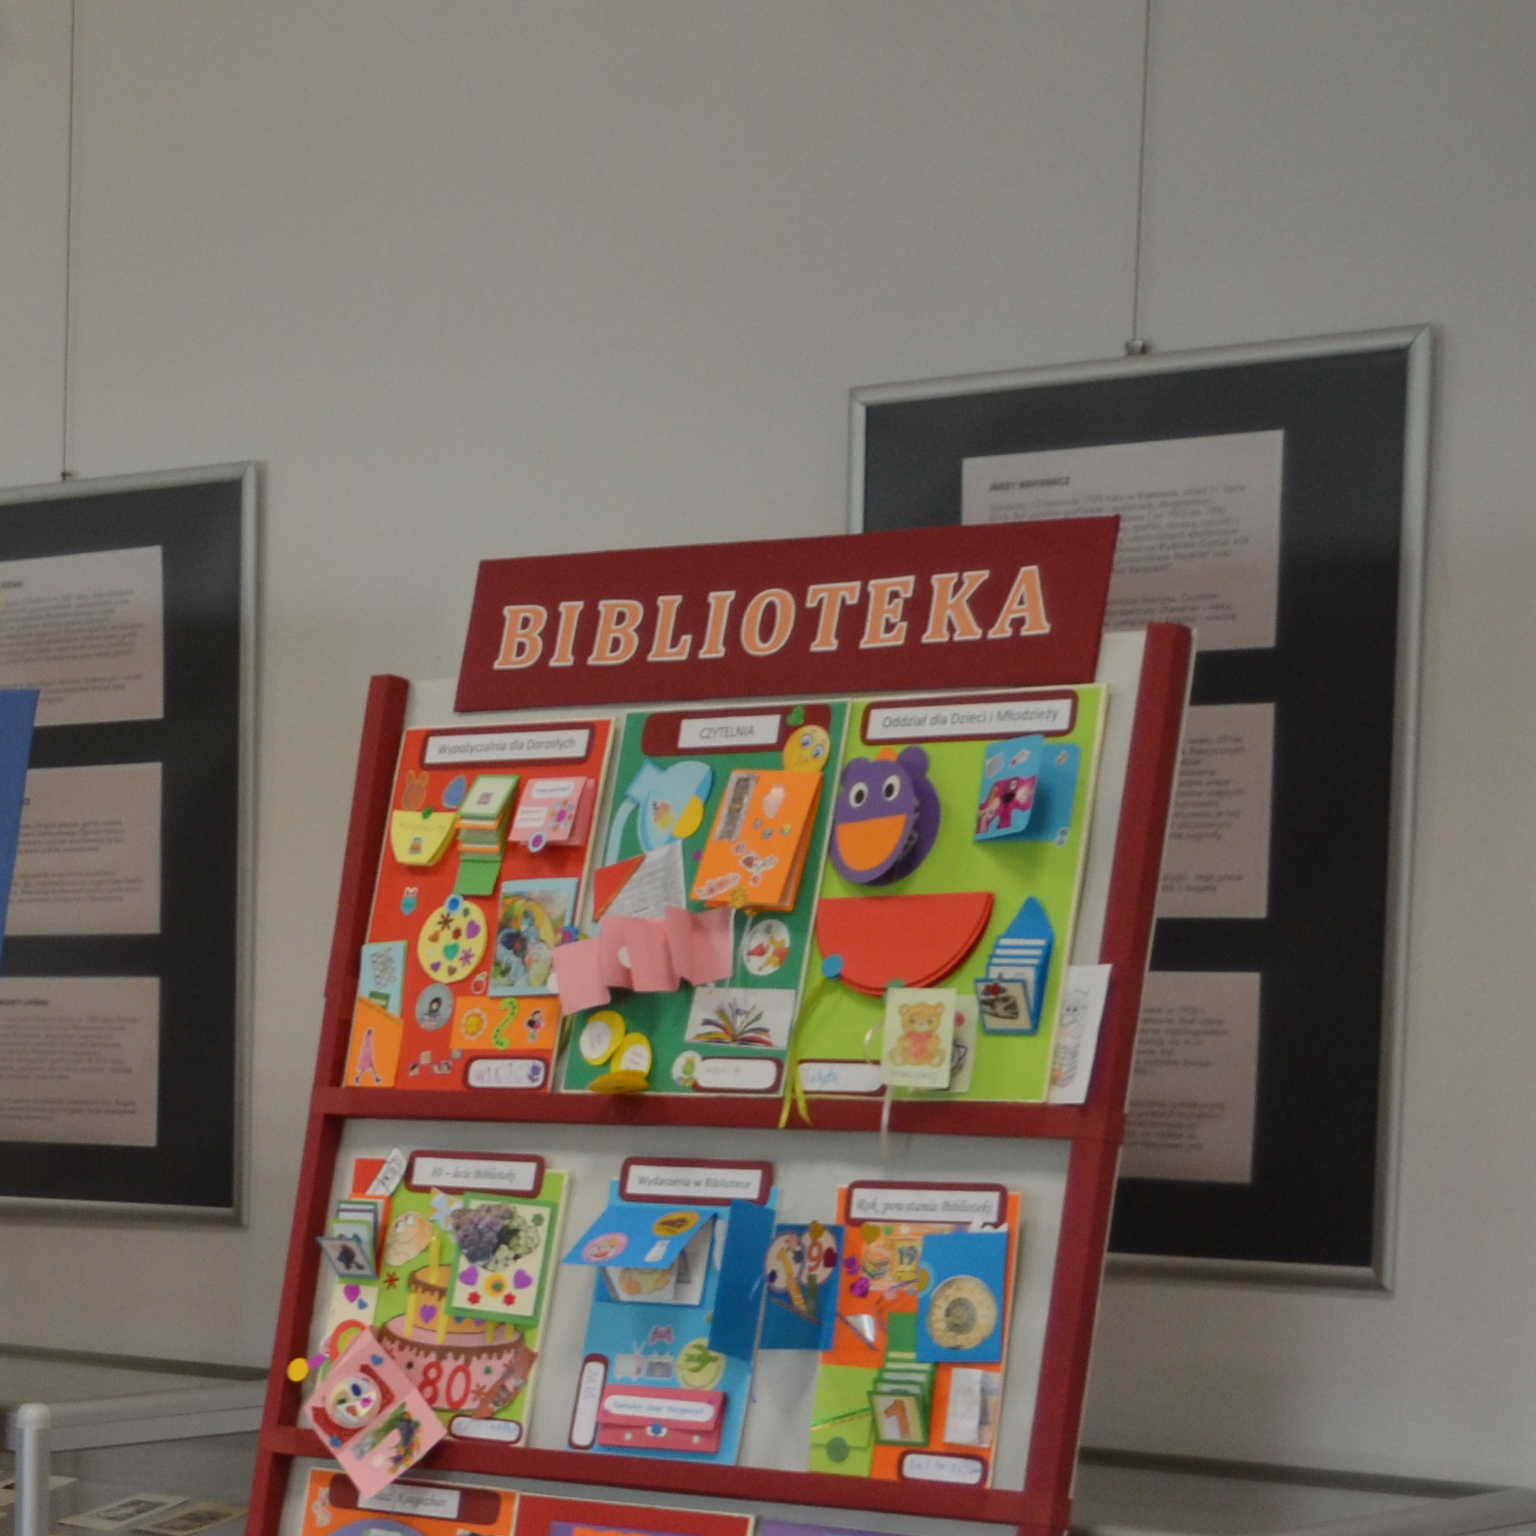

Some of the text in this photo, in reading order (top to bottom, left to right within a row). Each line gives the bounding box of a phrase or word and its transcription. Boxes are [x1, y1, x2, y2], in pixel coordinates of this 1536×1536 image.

[492, 565, 1051, 670] BIBLIOTEKA
[930, 713, 948, 726] dla
[950, 710, 989, 724] Dzieci
[510, 739, 525, 751] dla
[698, 725, 756, 740] CZYTELNIA
[419, 1360, 472, 1410] 80
[884, 1398, 911, 1439] 1
